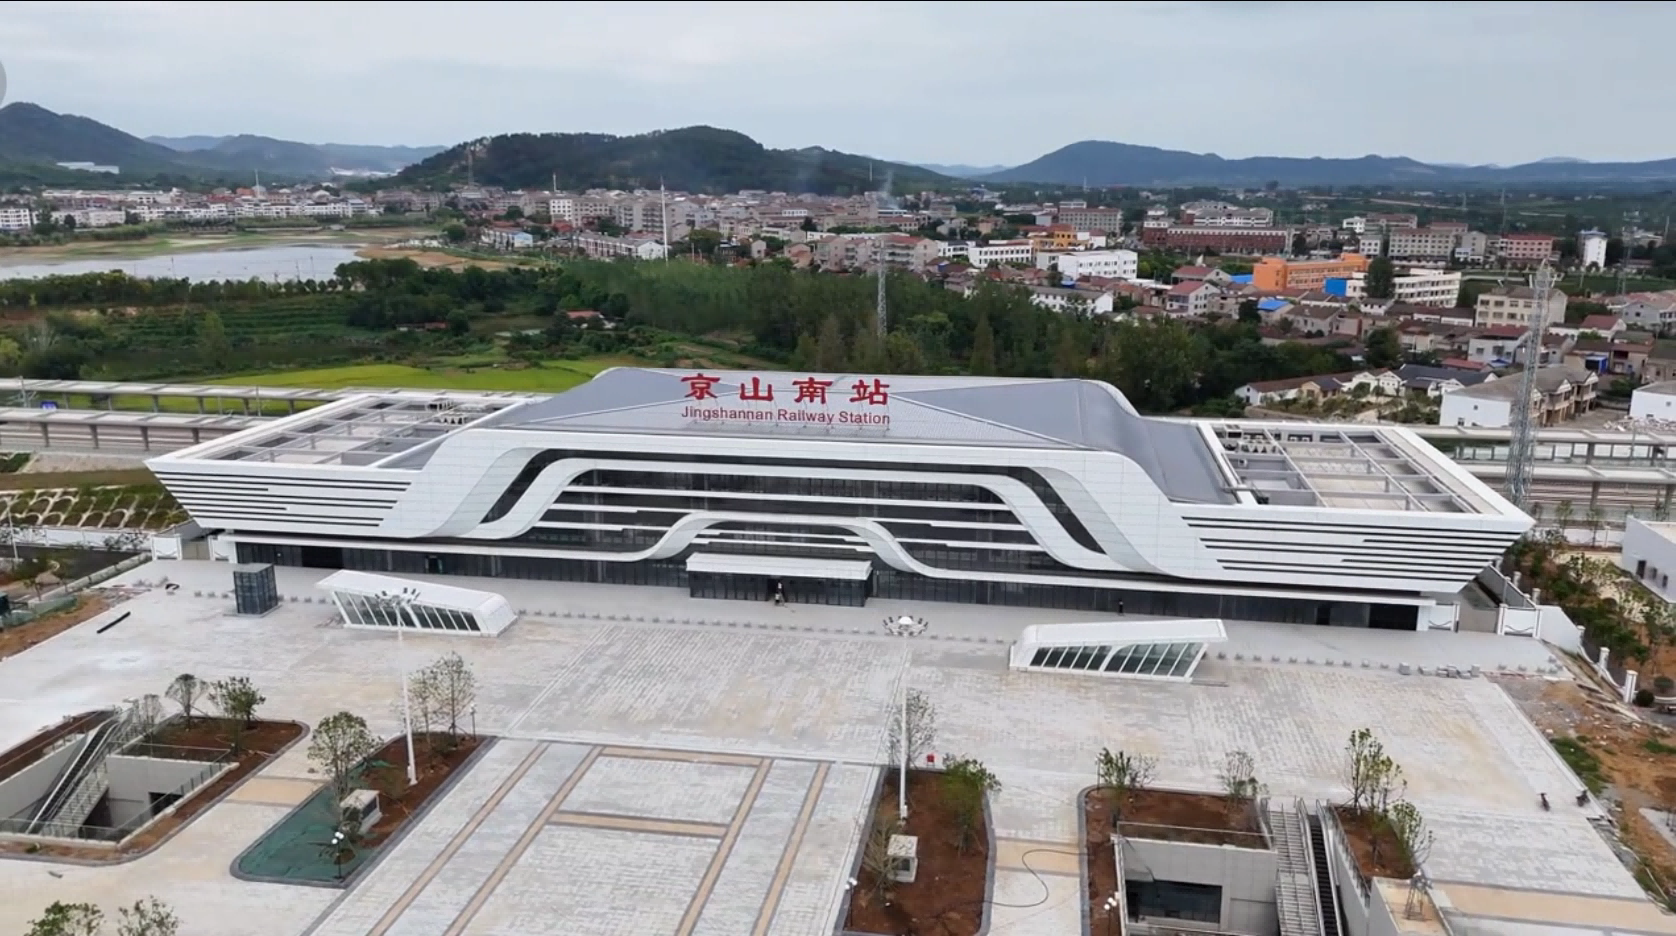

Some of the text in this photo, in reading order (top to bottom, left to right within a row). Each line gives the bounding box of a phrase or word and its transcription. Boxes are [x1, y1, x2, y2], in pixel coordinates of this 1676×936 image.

[681, 373, 890, 406] 京山南站
[681, 406, 890, 425] Jingshannan Railway Station
